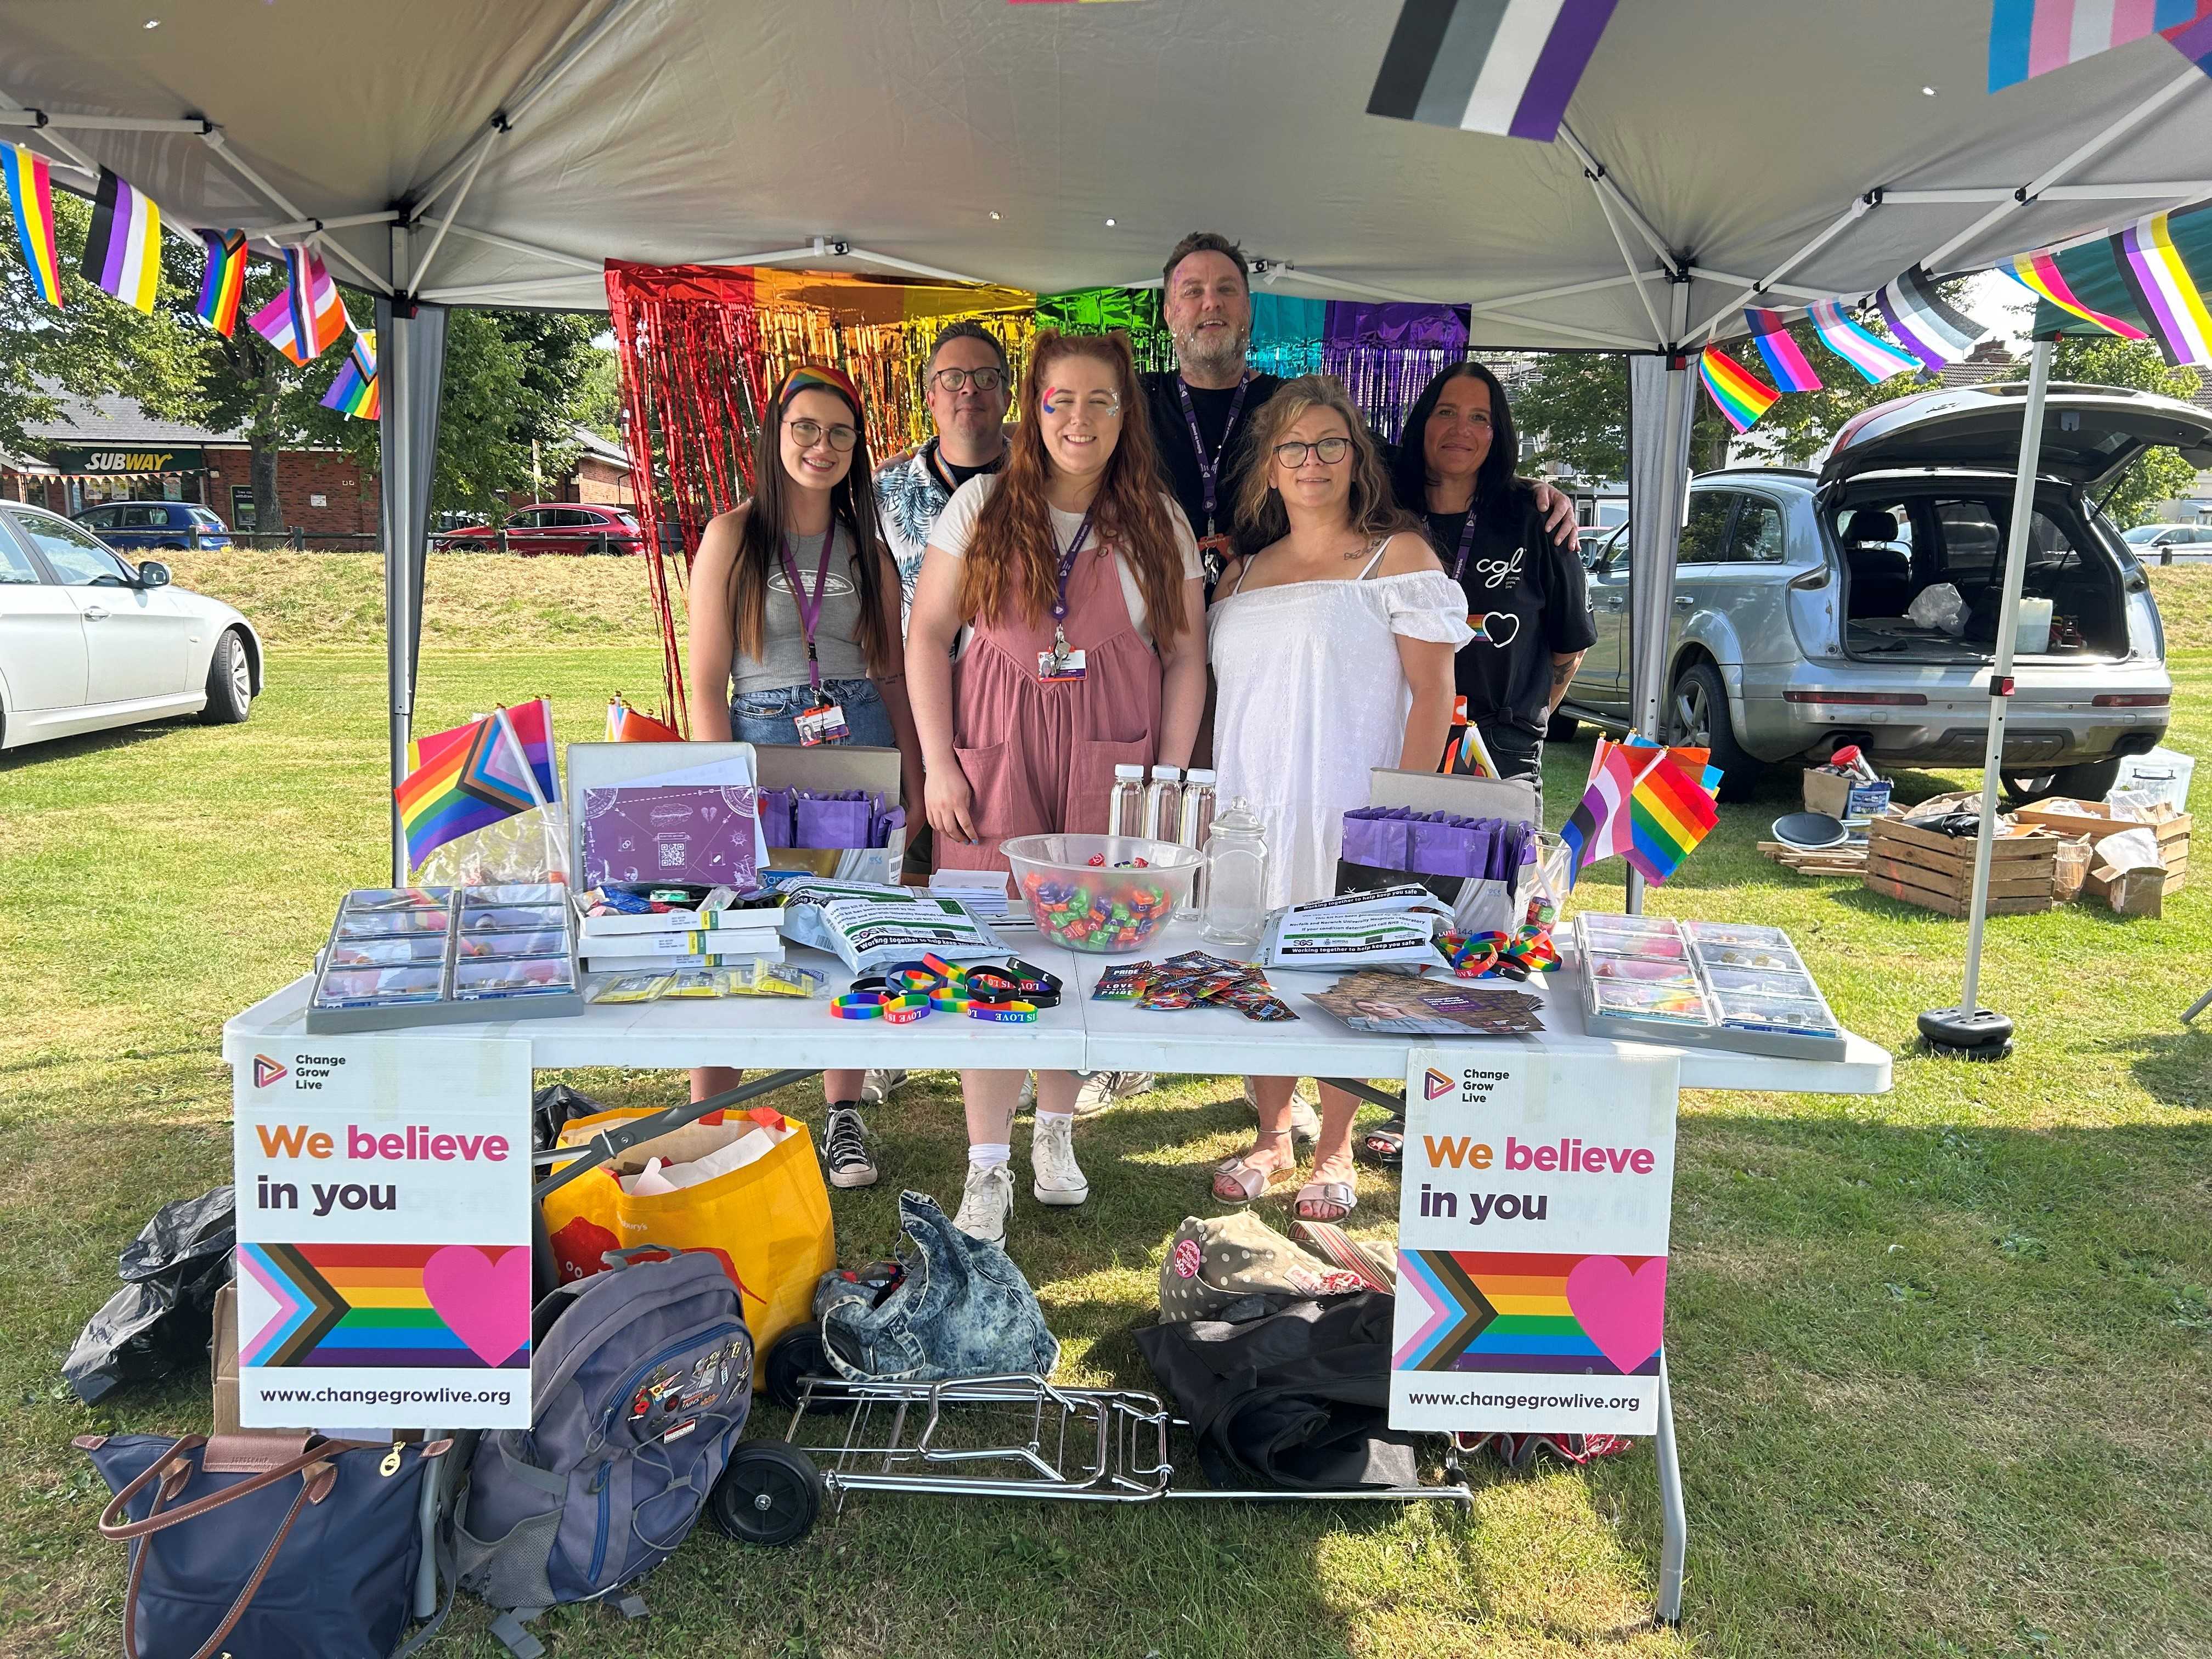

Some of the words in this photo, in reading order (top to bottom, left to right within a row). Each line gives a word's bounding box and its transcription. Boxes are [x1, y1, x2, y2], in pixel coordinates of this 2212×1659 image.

[85, 453, 173, 470] SUBWAY
[1476, 547, 1523, 588] cgl
[1328, 898, 1353, 906] together
[1458, 928, 1473, 936] 144
[860, 938, 889, 949] Workng
[888, 1013, 896, 1022] IS
[899, 1010, 922, 1023] LOVE
[967, 1009, 978, 1018] LO
[995, 1013, 1024, 1022] LOVE
[1026, 1013, 1036, 1022] IS
[295, 1054, 346, 1067] Change
[295, 1067, 330, 1078] Grow
[1463, 1068, 1510, 1081] Change
[295, 1080, 323, 1090] Live
[1462, 1081, 1494, 1091] Grow
[1462, 1092, 1487, 1103] Live
[256, 1125, 334, 1159] We
[347, 1125, 509, 1161] believe
[1423, 1135, 1493, 1169] We
[1505, 1136, 1655, 1175] believe
[257, 1175, 298, 1210] in
[312, 1183, 397, 1216] you
[1420, 1183, 1457, 1217] in
[1469, 1192, 1548, 1226] you
[260, 1387, 511, 1405] www.changegrowlive.org
[1408, 1391, 1640, 1412] www.changegrowlive.org
